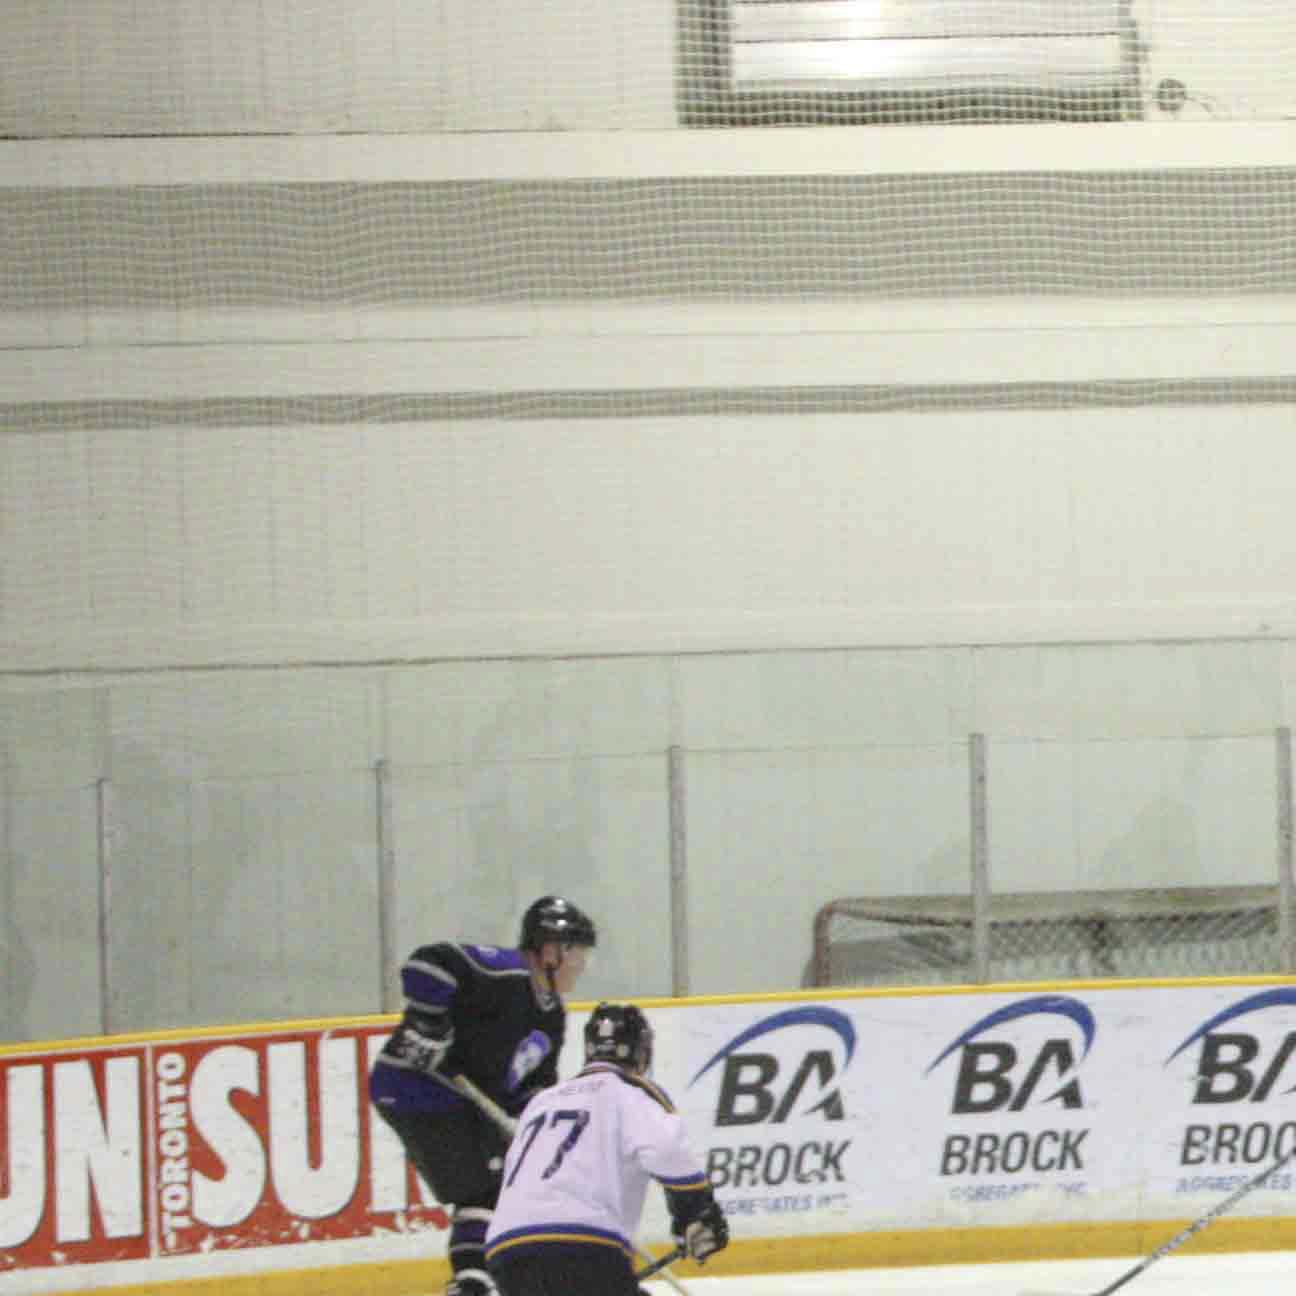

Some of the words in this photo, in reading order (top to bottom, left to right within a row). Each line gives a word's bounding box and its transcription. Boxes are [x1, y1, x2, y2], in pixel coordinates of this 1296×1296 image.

[714, 1050, 844, 1127] BA
[951, 1039, 1083, 1115] BA
[156, 1052, 192, 1236] TORONTO
[705, 1140, 853, 1189] BROCK
[939, 1128, 1091, 1176] BROCK
